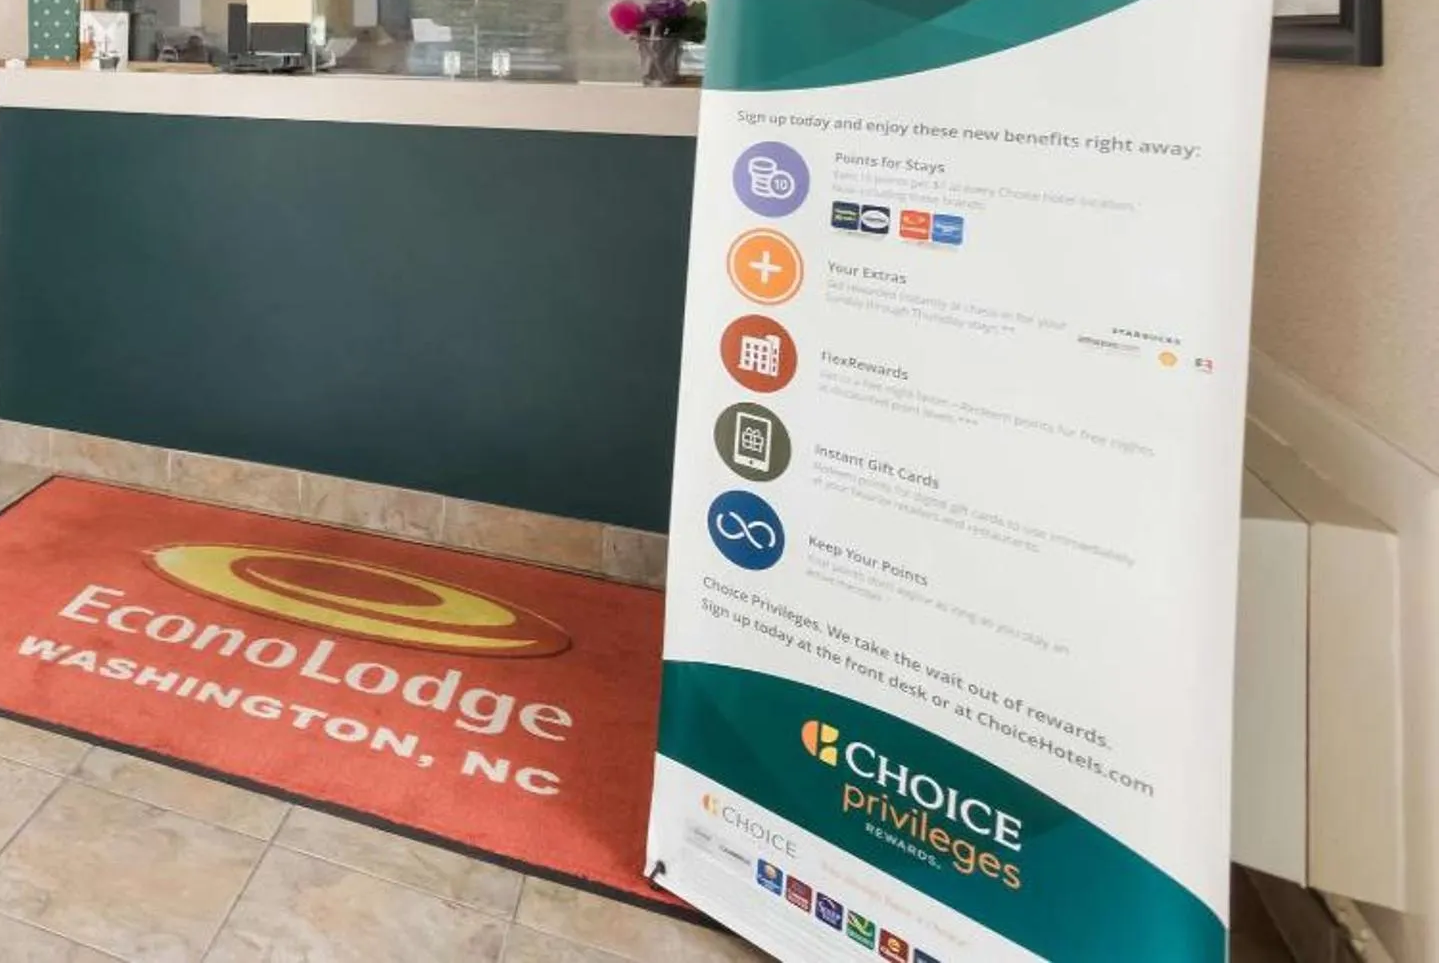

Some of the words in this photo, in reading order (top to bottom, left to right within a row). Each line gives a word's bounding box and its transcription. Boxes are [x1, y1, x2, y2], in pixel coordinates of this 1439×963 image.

[737, 110, 766, 125] Sign
[769, 114, 787, 126] up
[789, 114, 829, 130] today
[834, 118, 861, 131] and
[866, 120, 908, 137] enjoy
[913, 122, 958, 138] these
[963, 128, 1000, 142] new
[1004, 129, 1080, 148] benefits
[1085, 135, 1133, 154] right
[1139, 140, 1202, 160] away:
[835, 152, 878, 168] Points
[881, 155, 900, 170] for
[905, 157, 946, 175] Stays
[827, 259, 860, 277] Your
[863, 266, 907, 285] Extras
[814, 443, 864, 468] Instant
[868, 458, 895, 476] Gift
[897, 466, 940, 490] Cards
[808, 534, 844, 557] Keep
[846, 546, 879, 570] Your
[882, 559, 929, 587] Points
[703, 576, 749, 604] Choice
[751, 593, 823, 635] Privileges.
[826, 621, 851, 644] We
[854, 634, 890, 660] take
[894, 649, 922, 673] the
[926, 663, 964, 689] wait
[968, 682, 999, 705] out
[1003, 696, 1024, 714] of
[1027, 705, 1113, 751] rewards.
[17, 634, 437, 769] WASHINGTON,
[460, 750, 562, 797] NC
[701, 598, 730, 619] Sign
[732, 612, 751, 629] up
[754, 619, 794, 647] today
[797, 638, 812, 654] at
[816, 644, 842, 666] the
[845, 654, 885, 683] front
[888, 673, 928, 702] desk
[932, 694, 950, 710] or
[954, 703, 973, 722] at
[976, 711, 1155, 799] ChoiceHotels.com
[845, 740, 1024, 853] CHOICE
[721, 805, 798, 860] CHOICE
[842, 781, 1022, 891] privileges
